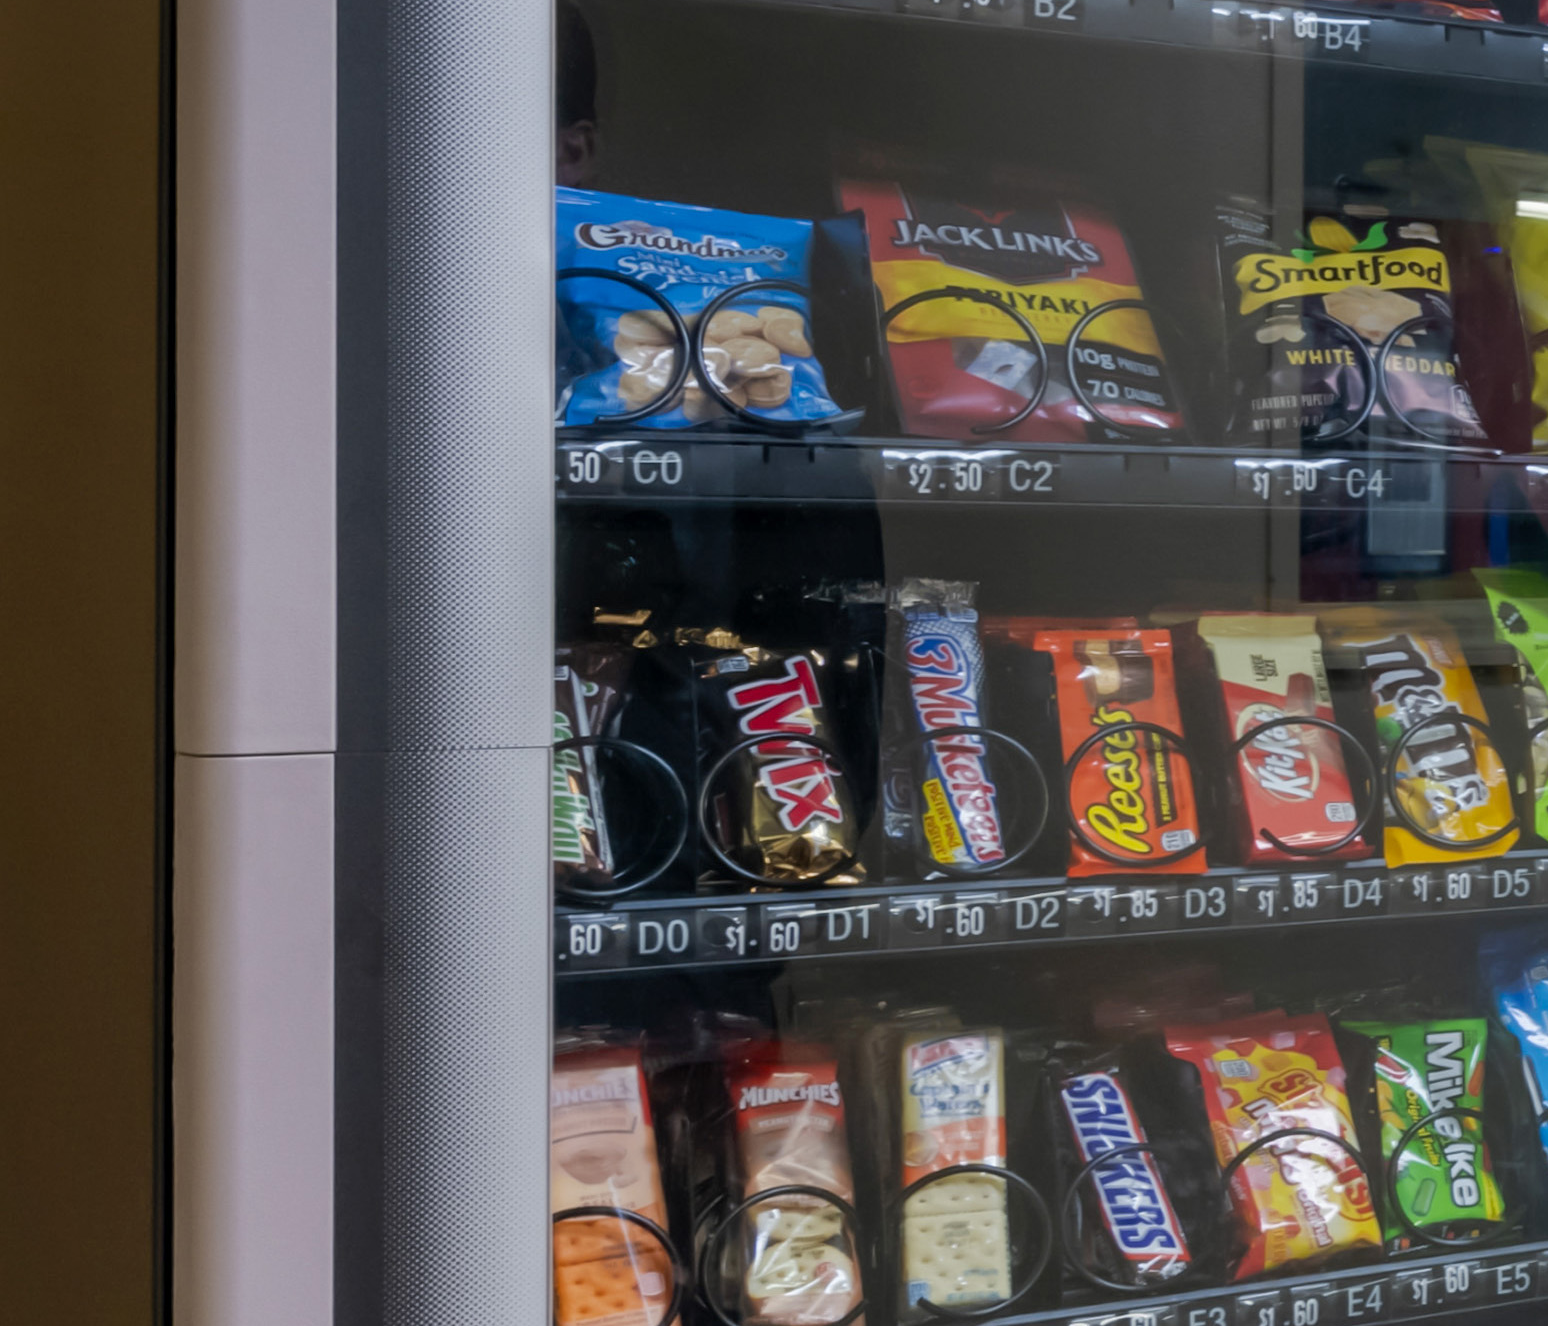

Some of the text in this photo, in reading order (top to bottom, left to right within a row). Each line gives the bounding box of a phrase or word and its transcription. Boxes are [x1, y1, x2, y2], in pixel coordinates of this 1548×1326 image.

[1324, 21, 1362, 52] B4
[576, 221, 790, 263] Grandma's
[894, 219, 1100, 262] JACK LINK'S
[1250, 254, 1443, 293] Smartfood
[1074, 347, 1116, 371] 10g
[1286, 349, 1356, 366] WHITE
[1087, 379, 1119, 399] 70
[1009, 460, 1053, 492] C2
[1346, 468, 1386, 499] C4
[905, 635, 955, 671] 3
[727, 655, 843, 831] TWIX
[1087, 705, 1152, 854] Reese's
[1344, 879, 1383, 908] D4
[1493, 869, 1530, 898] D5
[1016, 897, 1060, 930] D2
[1185, 887, 1227, 918] D3
[828, 908, 870, 941] D1
[738, 1080, 841, 1110] MUNCHIES
[1425, 1030, 1481, 1208] Mike Ike
[1063, 1073, 1178, 1251] SNICKERS
[1497, 1263, 1531, 1295] E5
[1348, 1284, 1384, 1318] E4
